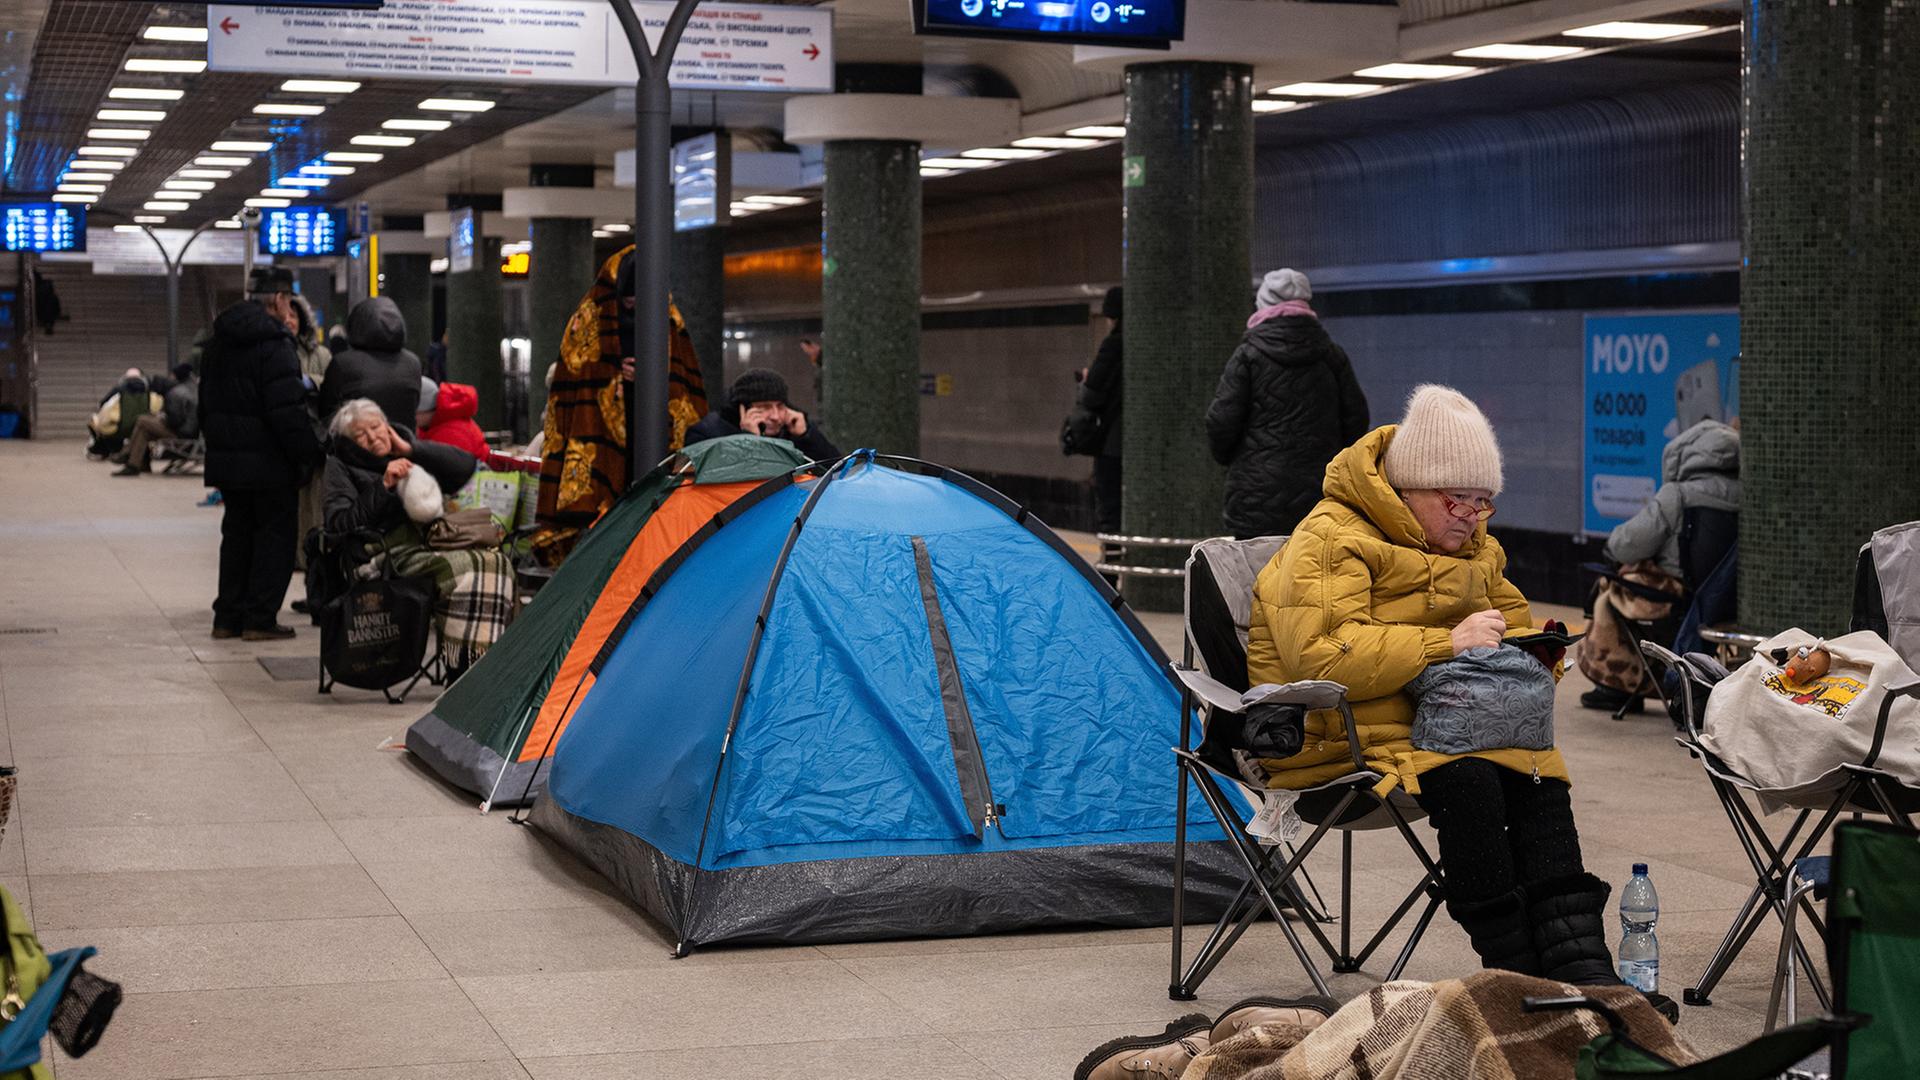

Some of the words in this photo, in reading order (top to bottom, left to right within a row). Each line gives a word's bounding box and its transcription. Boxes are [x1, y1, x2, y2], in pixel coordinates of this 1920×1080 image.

[1592, 334, 1669, 374] MOYO
[1594, 392, 1613, 416] 60
[1615, 392, 1647, 416] 000
